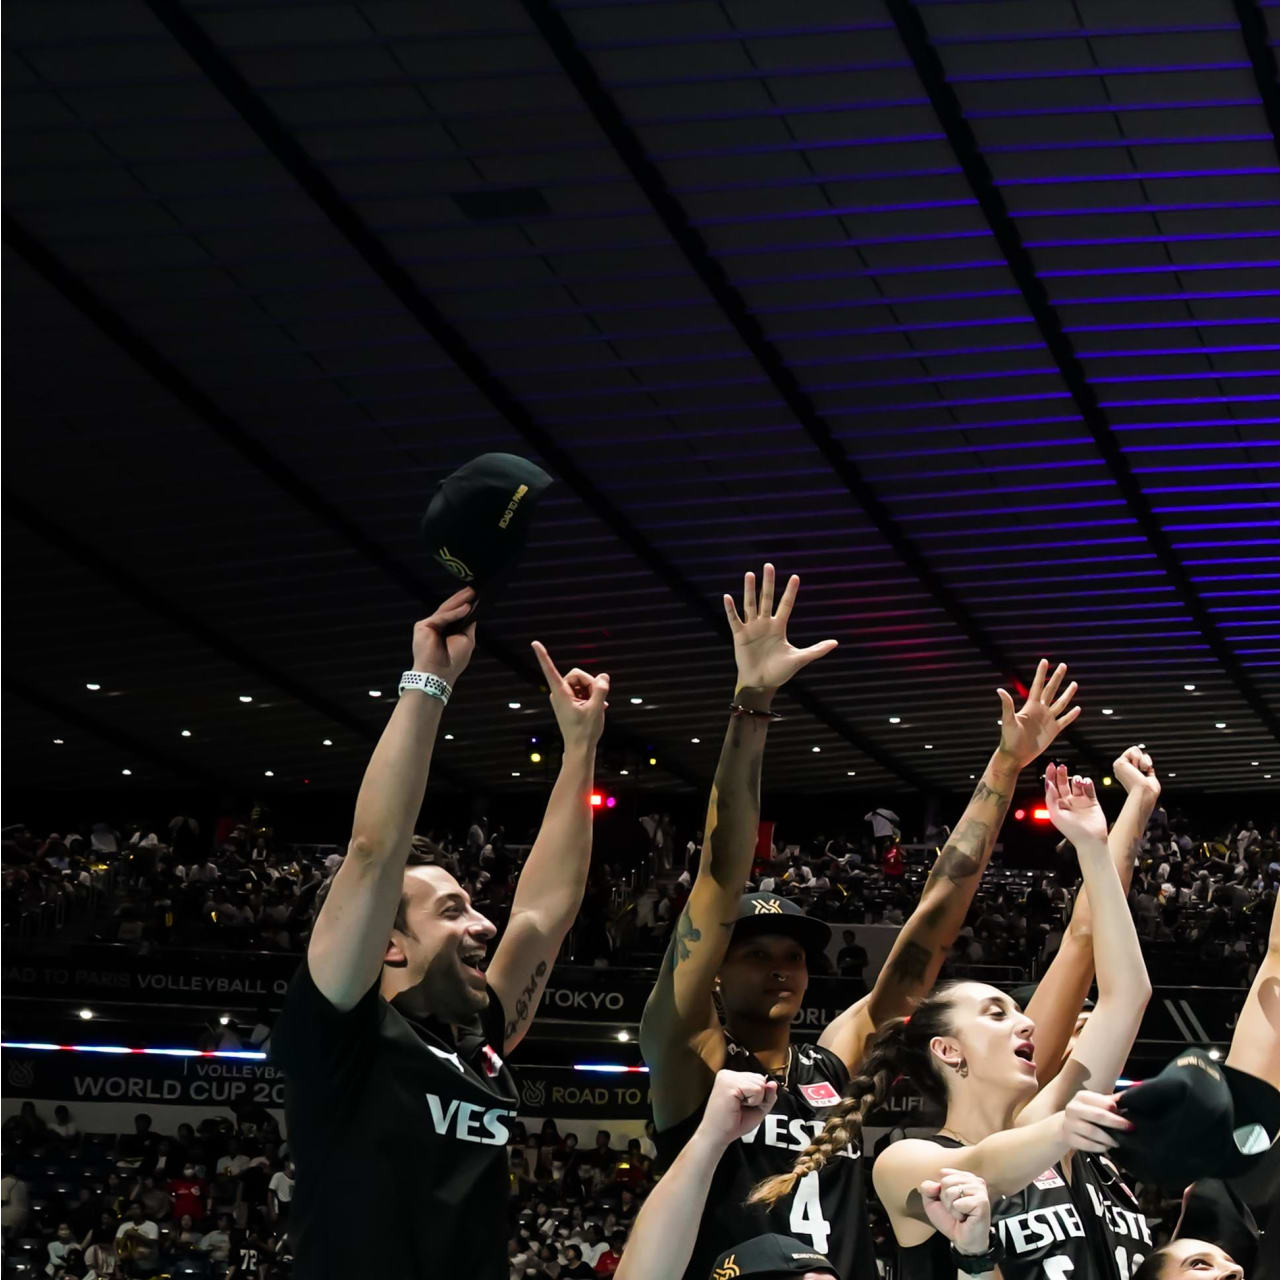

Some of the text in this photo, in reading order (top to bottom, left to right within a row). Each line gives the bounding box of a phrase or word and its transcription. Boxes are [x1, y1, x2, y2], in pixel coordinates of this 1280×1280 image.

[136, 973, 268, 994] VOLLEYBALL
[543, 988, 625, 1011] TOKYO
[73, 1076, 182, 1099] WORLD
[189, 1081, 248, 1102] CUP
[552, 1087, 641, 1105] ROAD TO
[425, 1092, 518, 1147] VES
[789, 1169, 832, 1255] 4
